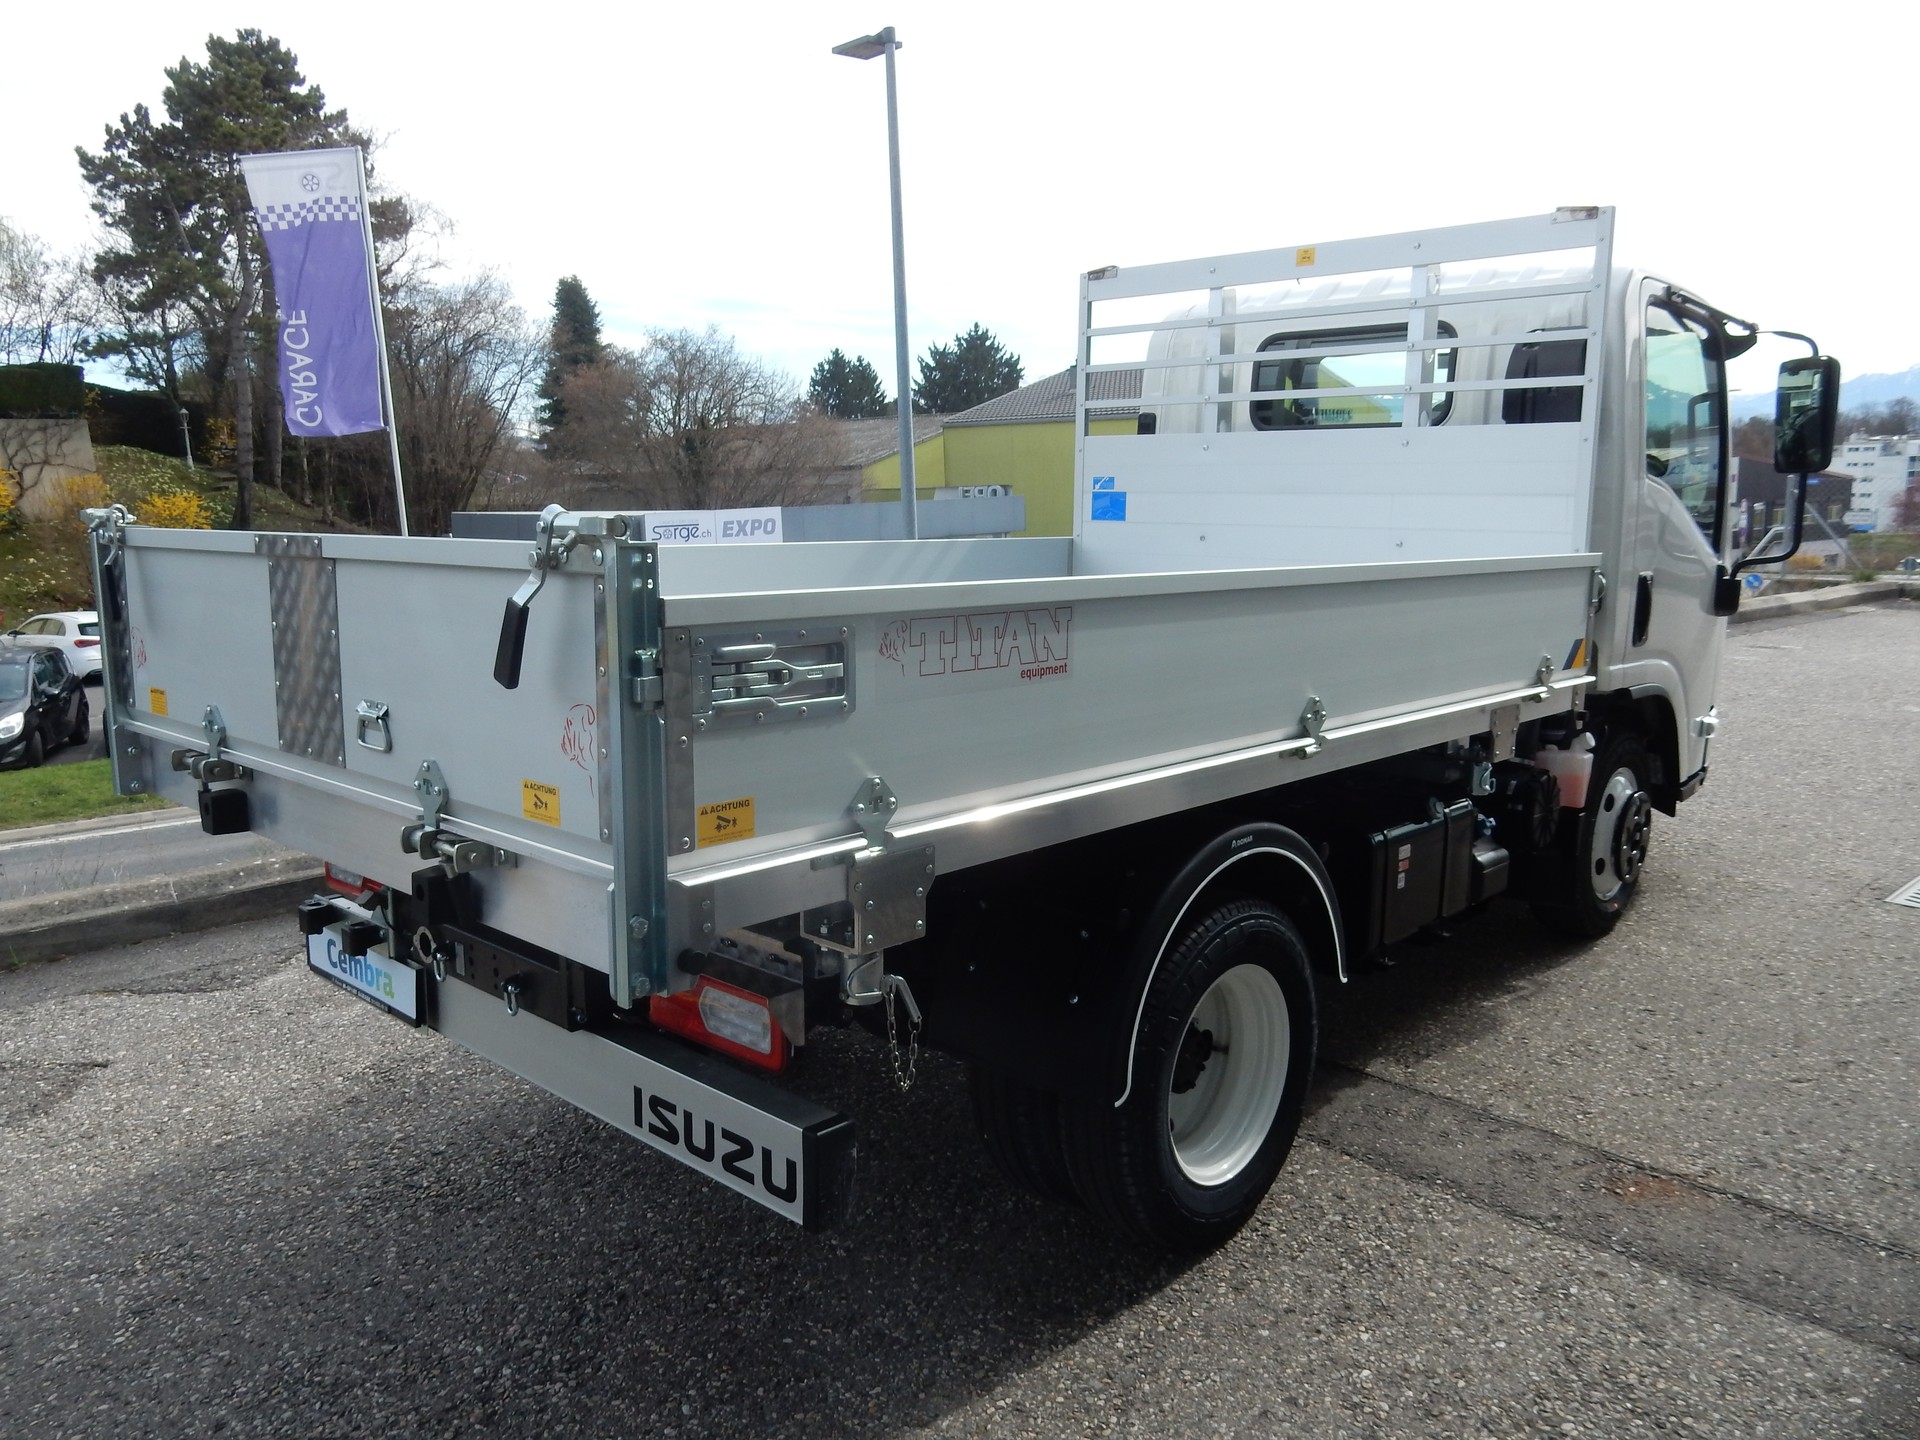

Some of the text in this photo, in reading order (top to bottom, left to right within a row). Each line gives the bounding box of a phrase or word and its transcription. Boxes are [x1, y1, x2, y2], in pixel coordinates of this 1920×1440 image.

[722, 518, 777, 537] EXPO
[909, 606, 1072, 677] TITAN
[1020, 663, 1068, 680] equipment
[530, 782, 557, 796] ACHTUNG
[709, 799, 750, 814] ACHTUNG
[327, 938, 395, 999] Cembra
[633, 1084, 798, 1204] ISUZU
